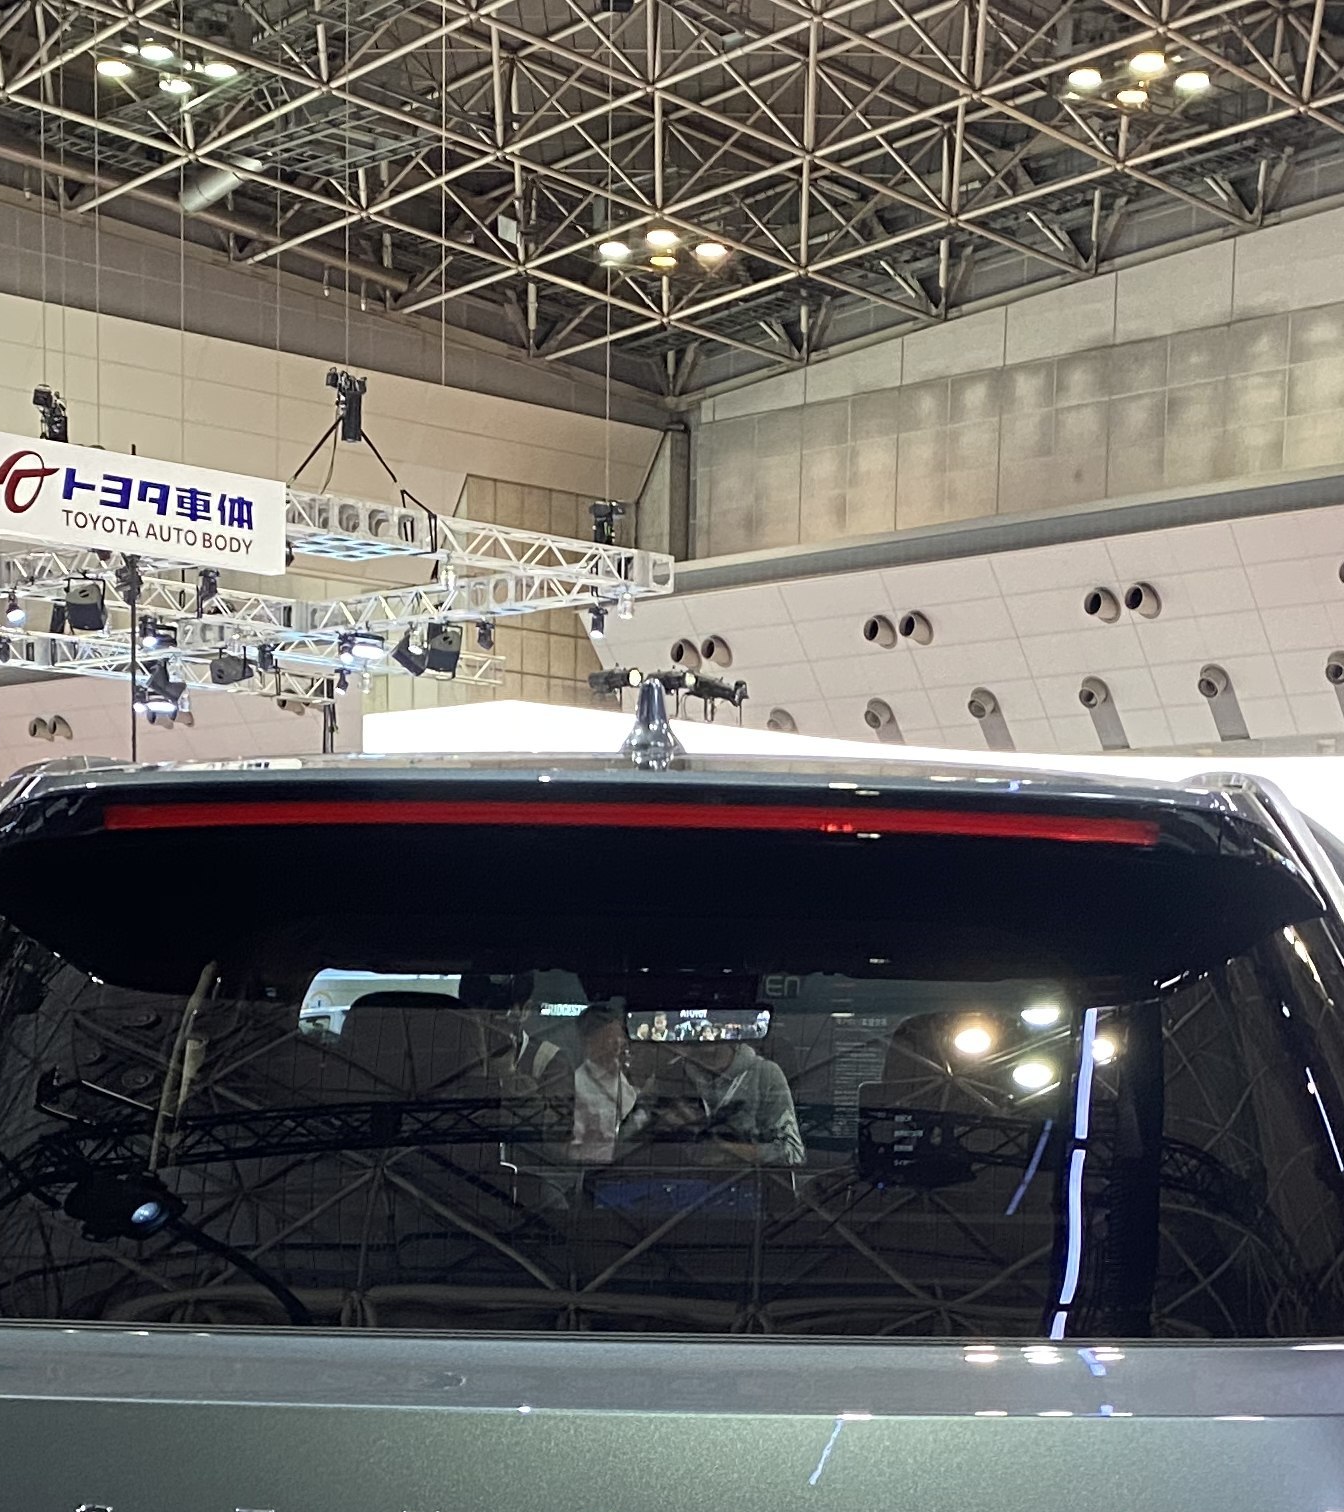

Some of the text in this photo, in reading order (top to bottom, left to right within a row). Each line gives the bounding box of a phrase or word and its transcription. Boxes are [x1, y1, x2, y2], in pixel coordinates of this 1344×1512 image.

[62, 467, 254, 531] トヨタ車体
[61, 508, 254, 556] TOYOTA AUTO BODY
